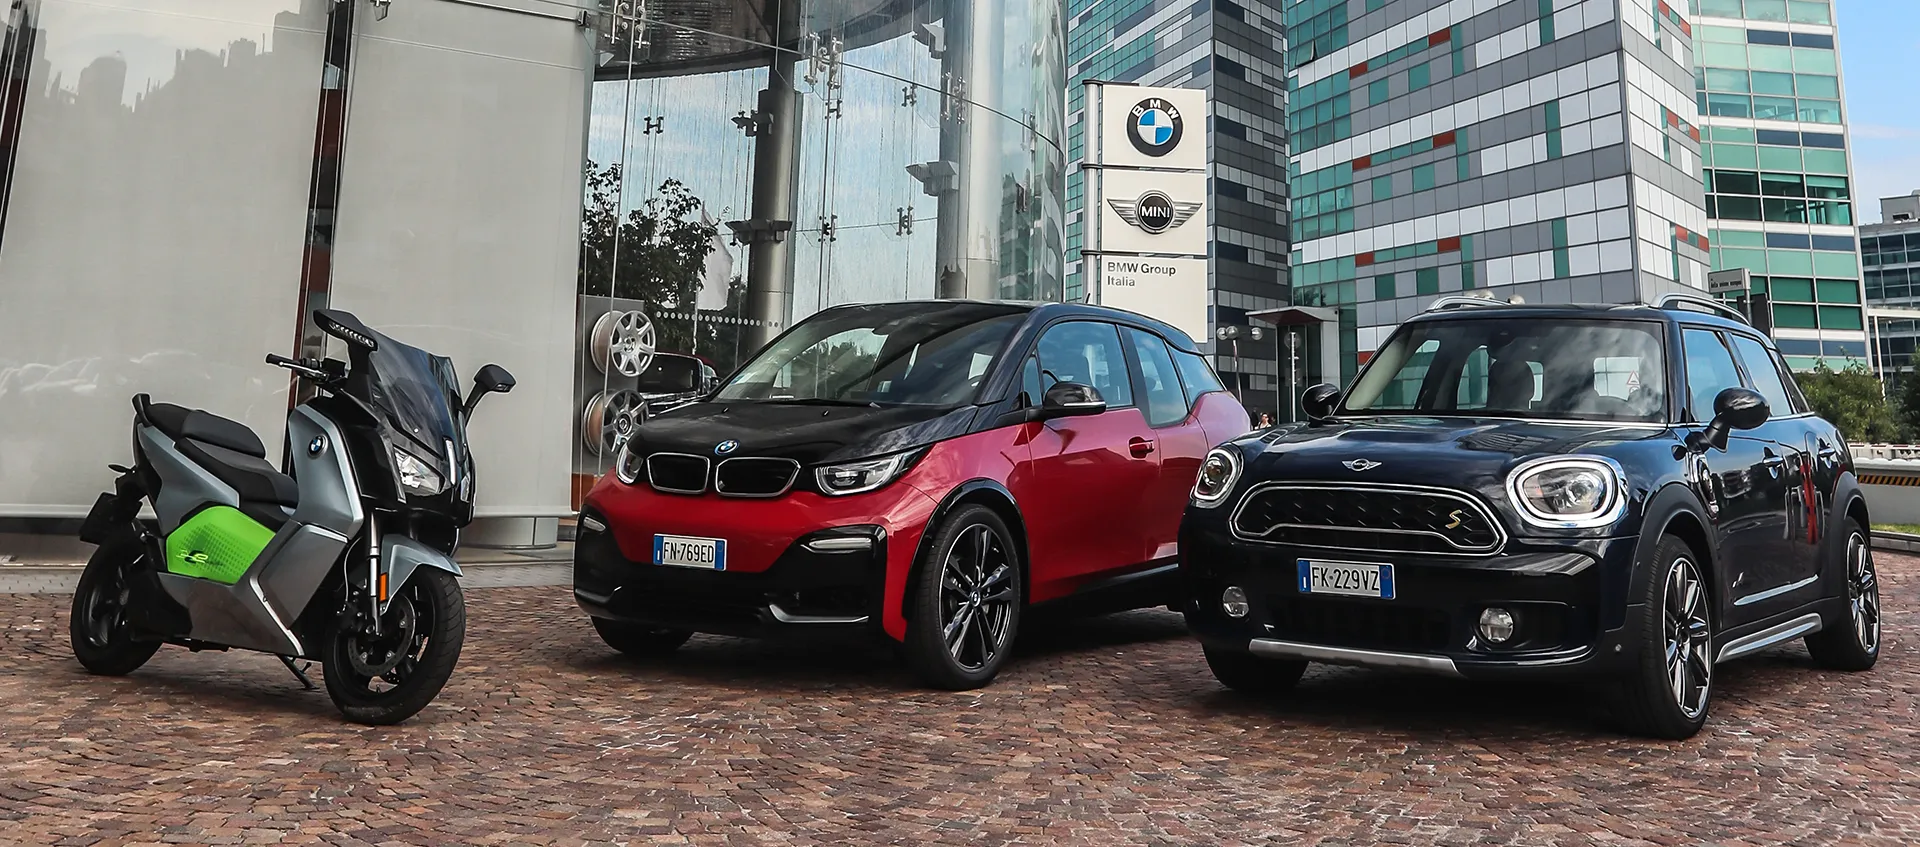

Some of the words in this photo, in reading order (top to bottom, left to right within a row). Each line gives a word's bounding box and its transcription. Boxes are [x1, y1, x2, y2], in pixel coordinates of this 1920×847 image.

[1131, 98, 1180, 120] BMW
[1141, 205, 1171, 218] MINI
[1107, 261, 1139, 273] BMW
[1140, 263, 1176, 277] Group
[1107, 275, 1135, 287] Italia
